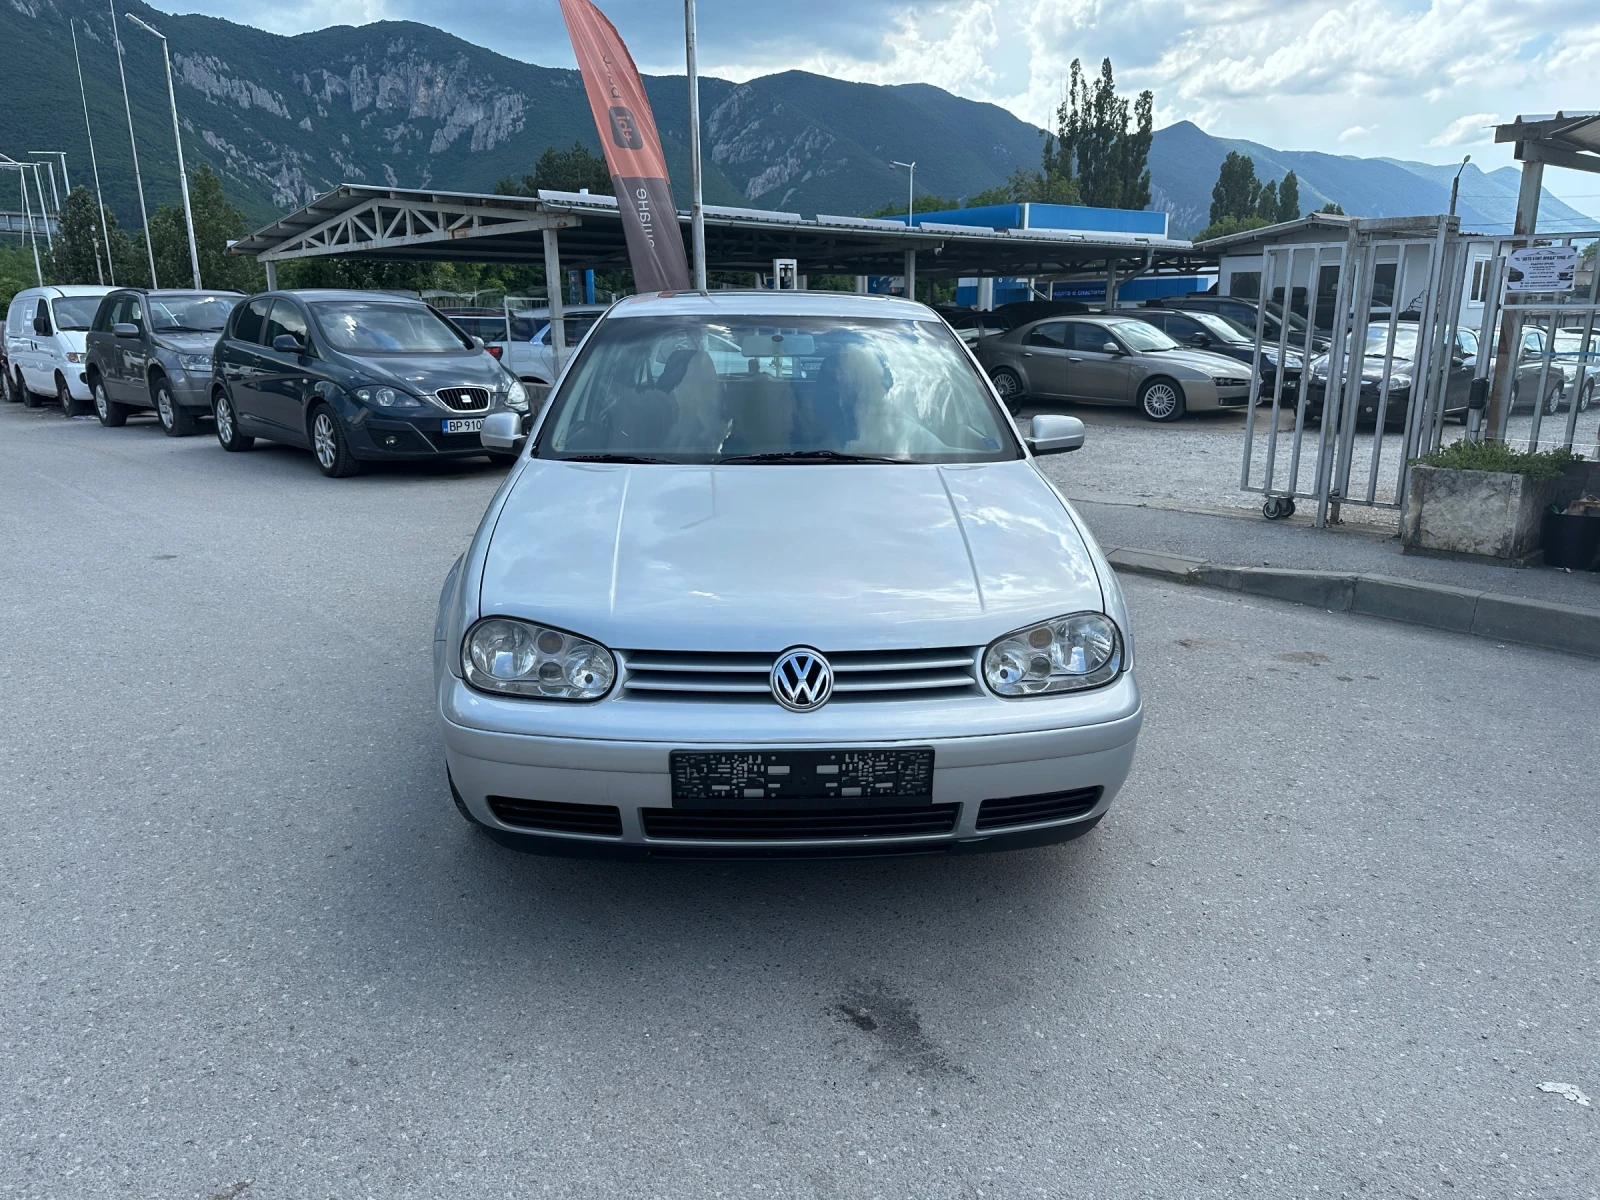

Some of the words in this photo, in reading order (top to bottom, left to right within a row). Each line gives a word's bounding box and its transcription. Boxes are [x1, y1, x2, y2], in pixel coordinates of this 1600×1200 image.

[449, 421, 463, 431] BP
[464, 420, 484, 431] 910
[772, 650, 832, 709] VW
